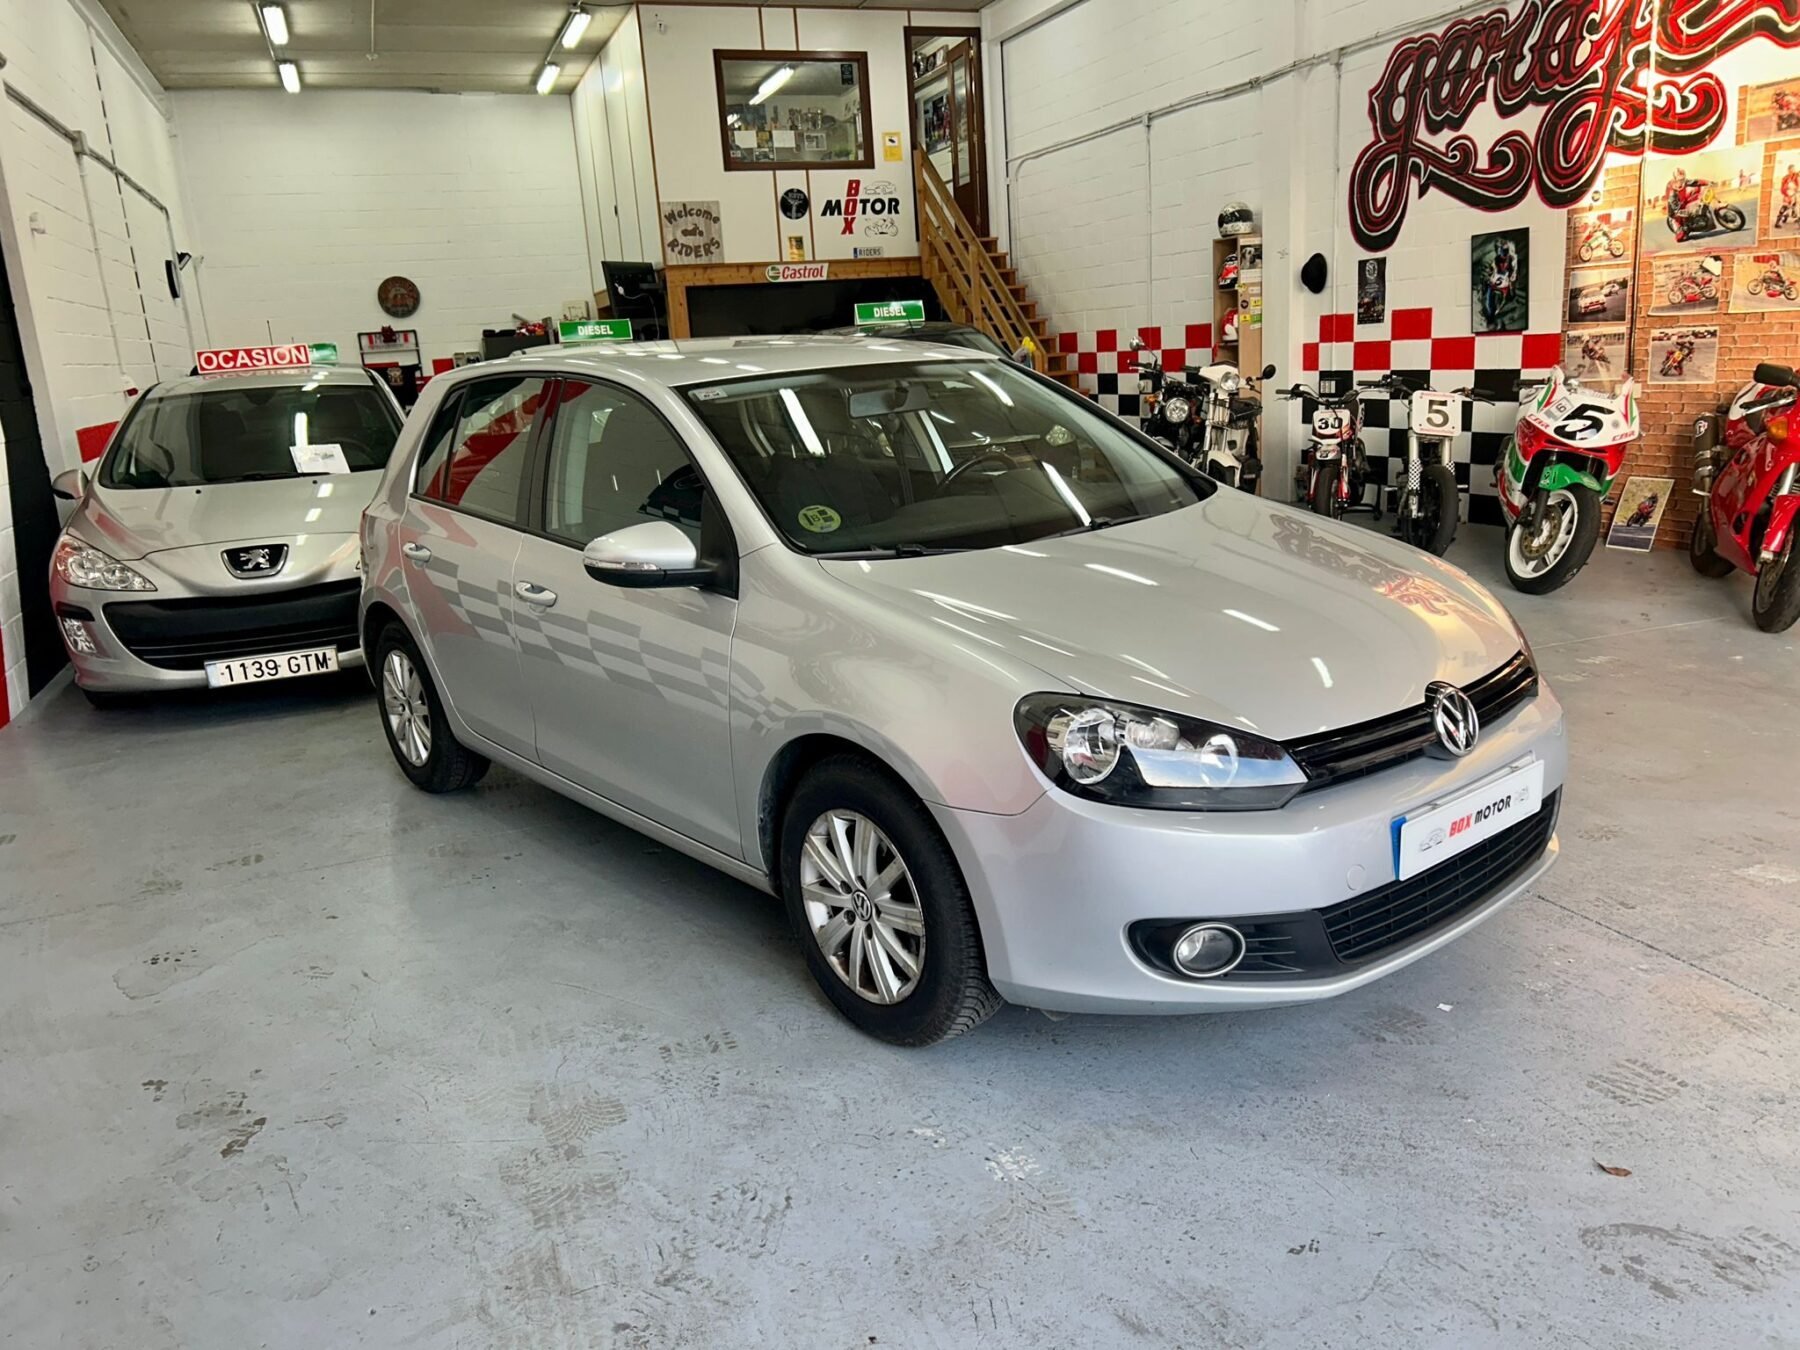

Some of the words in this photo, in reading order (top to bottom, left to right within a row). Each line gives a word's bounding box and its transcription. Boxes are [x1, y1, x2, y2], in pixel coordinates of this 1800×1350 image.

[664, 202, 720, 224] Welcome
[667, 237, 720, 258] RIDERS
[858, 248, 882, 257] RIDERS
[782, 265, 824, 280] Castrol
[873, 306, 907, 318] DIESEL
[577, 325, 614, 336] DIESEL
[1317, 416, 1344, 430] 30
[1426, 399, 1450, 428] 5
[1553, 403, 1616, 441] 5
[225, 659, 279, 682] 1139
[287, 652, 329, 674] GTM
[1474, 795, 1512, 825] MOTOR
[1449, 813, 1472, 837] BOX
